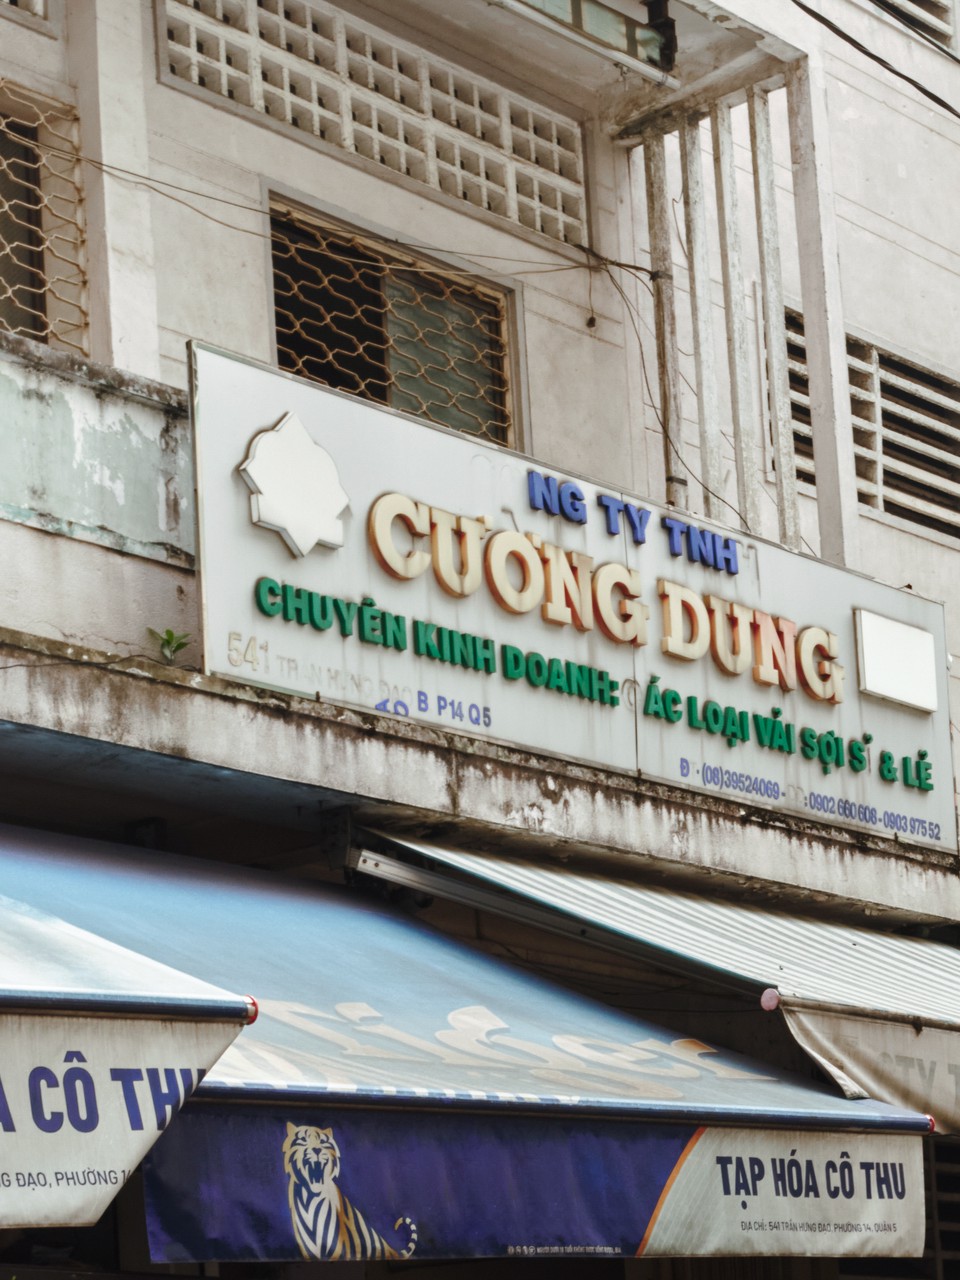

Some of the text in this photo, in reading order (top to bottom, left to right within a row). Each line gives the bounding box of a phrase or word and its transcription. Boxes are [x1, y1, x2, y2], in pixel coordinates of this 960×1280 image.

[598, 495, 651, 544] TY
[657, 578, 844, 704] DUNG
[255, 576, 407, 651] CHUYÊN
[413, 619, 496, 674] KINH
[501, 643, 620, 707] DOANH:
[687, 695, 750, 748] LOẠI
[753, 706, 796, 754] VẢI
[800, 727, 845, 775] SỢI
[879, 750, 898, 782] &
[902, 749, 934, 792] LẺ
[437, 695, 464, 722] P14
[702, 762, 780, 800] (08)39524069
[28, 1050, 99, 1133] CÔ
[16, 1171, 52, 1191] ĐẠO,
[55, 1167, 118, 1187] PHƯỜNG
[716, 1149, 906, 1210] TẠP HÓA CÔ THU
[768, 1221, 780, 1231] 541
